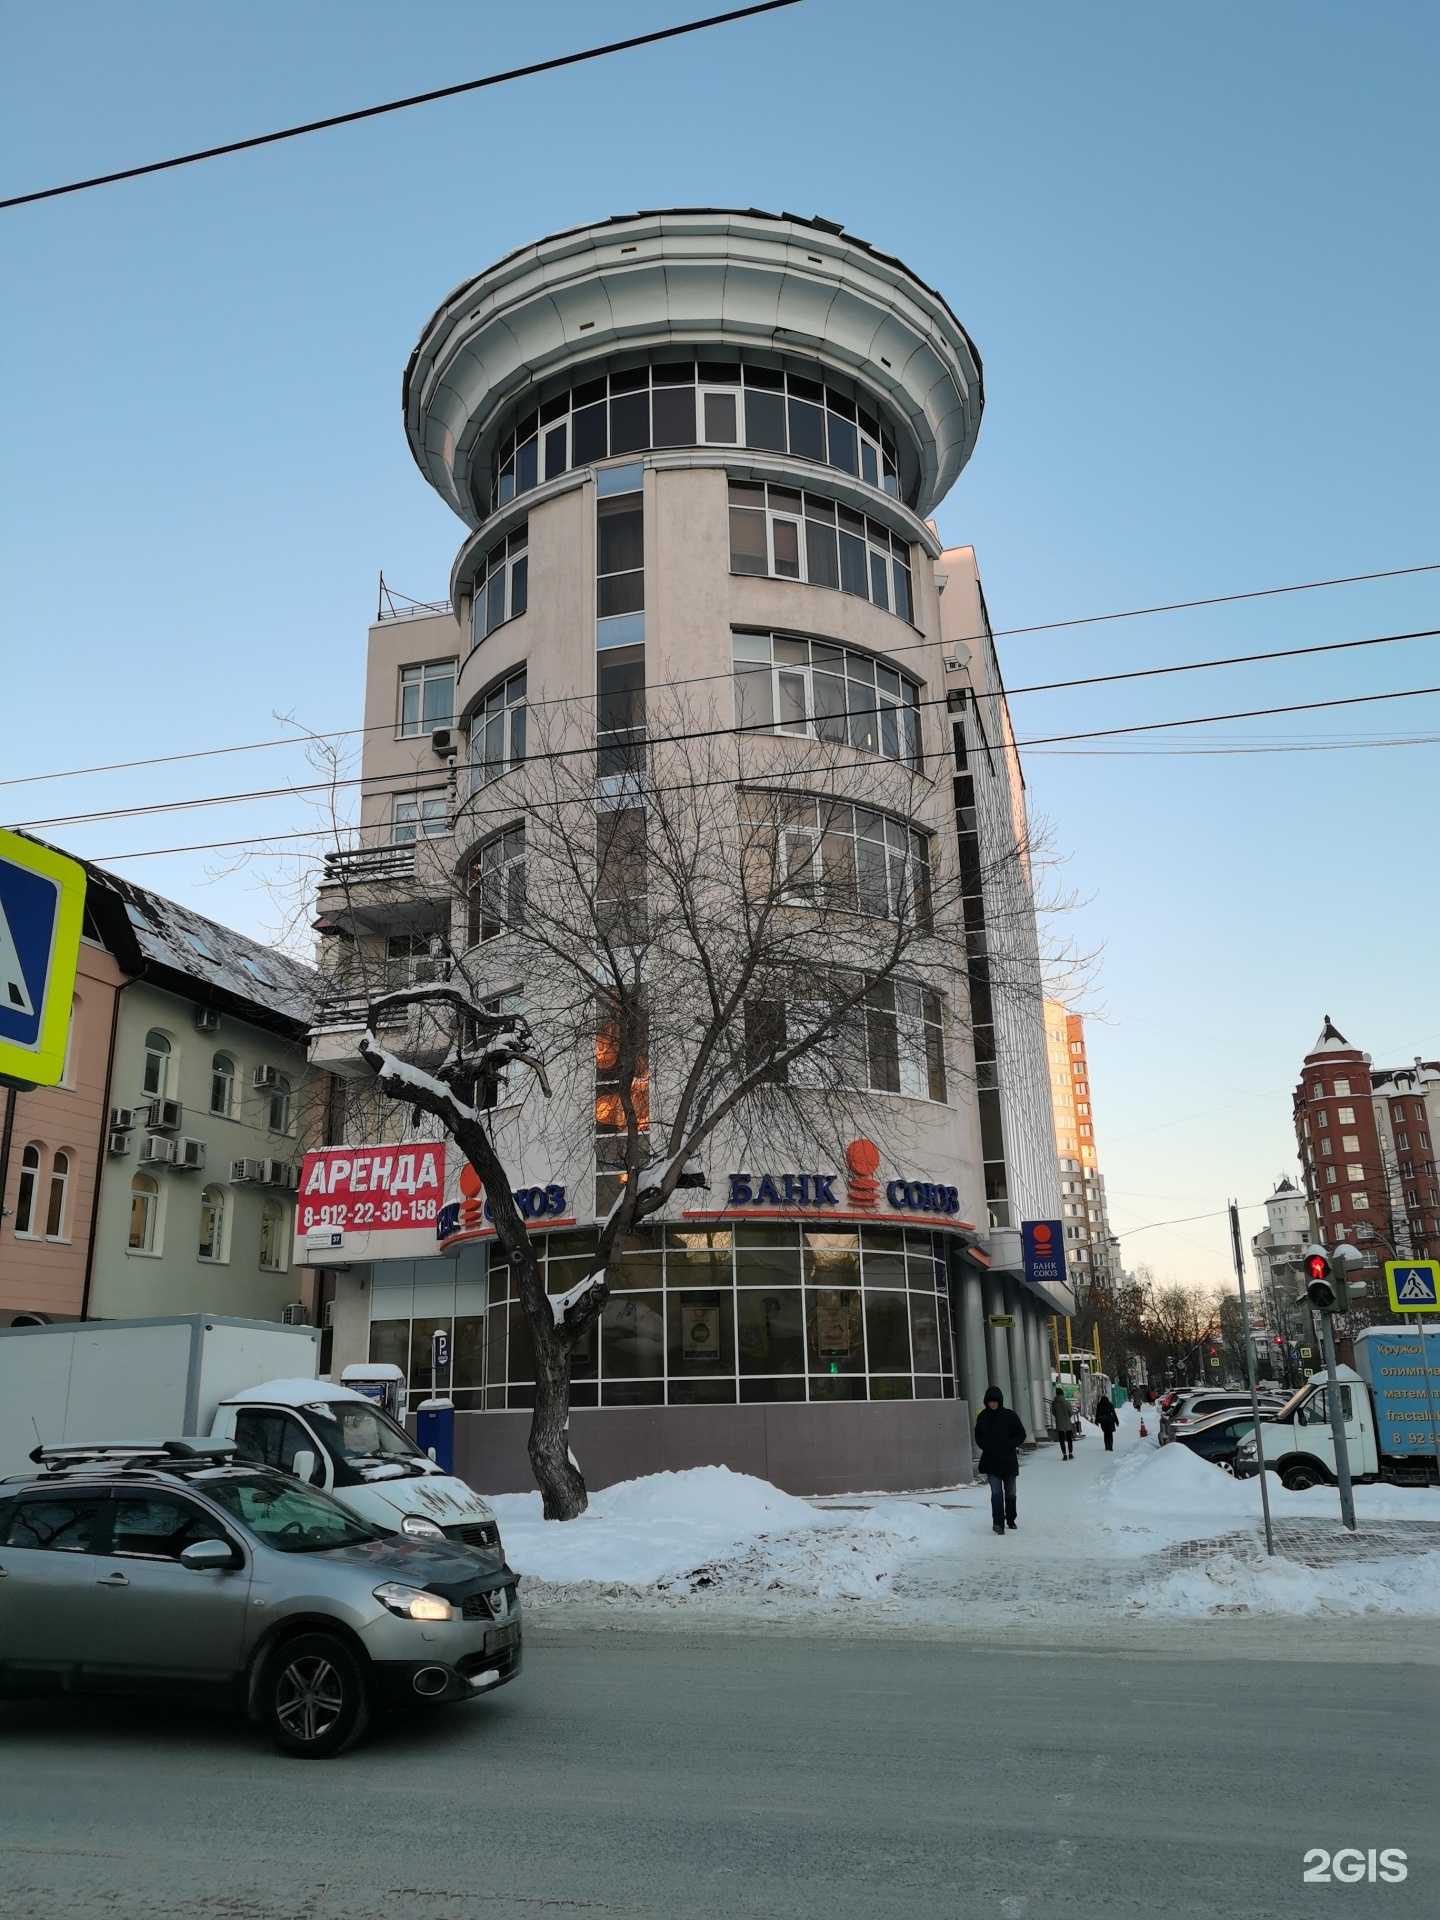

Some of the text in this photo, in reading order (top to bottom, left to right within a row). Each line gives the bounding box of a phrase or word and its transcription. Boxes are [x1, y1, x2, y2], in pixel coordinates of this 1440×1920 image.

[304, 1152, 438, 1196] АРЕНДА
[303, 1199, 437, 1227] 8-912-22-30-158
[483, 1184, 567, 1223] СЮЗ
[728, 1173, 960, 1215] БАНК СОЮЗ
[1033, 1262, 1056, 1270] БАНК
